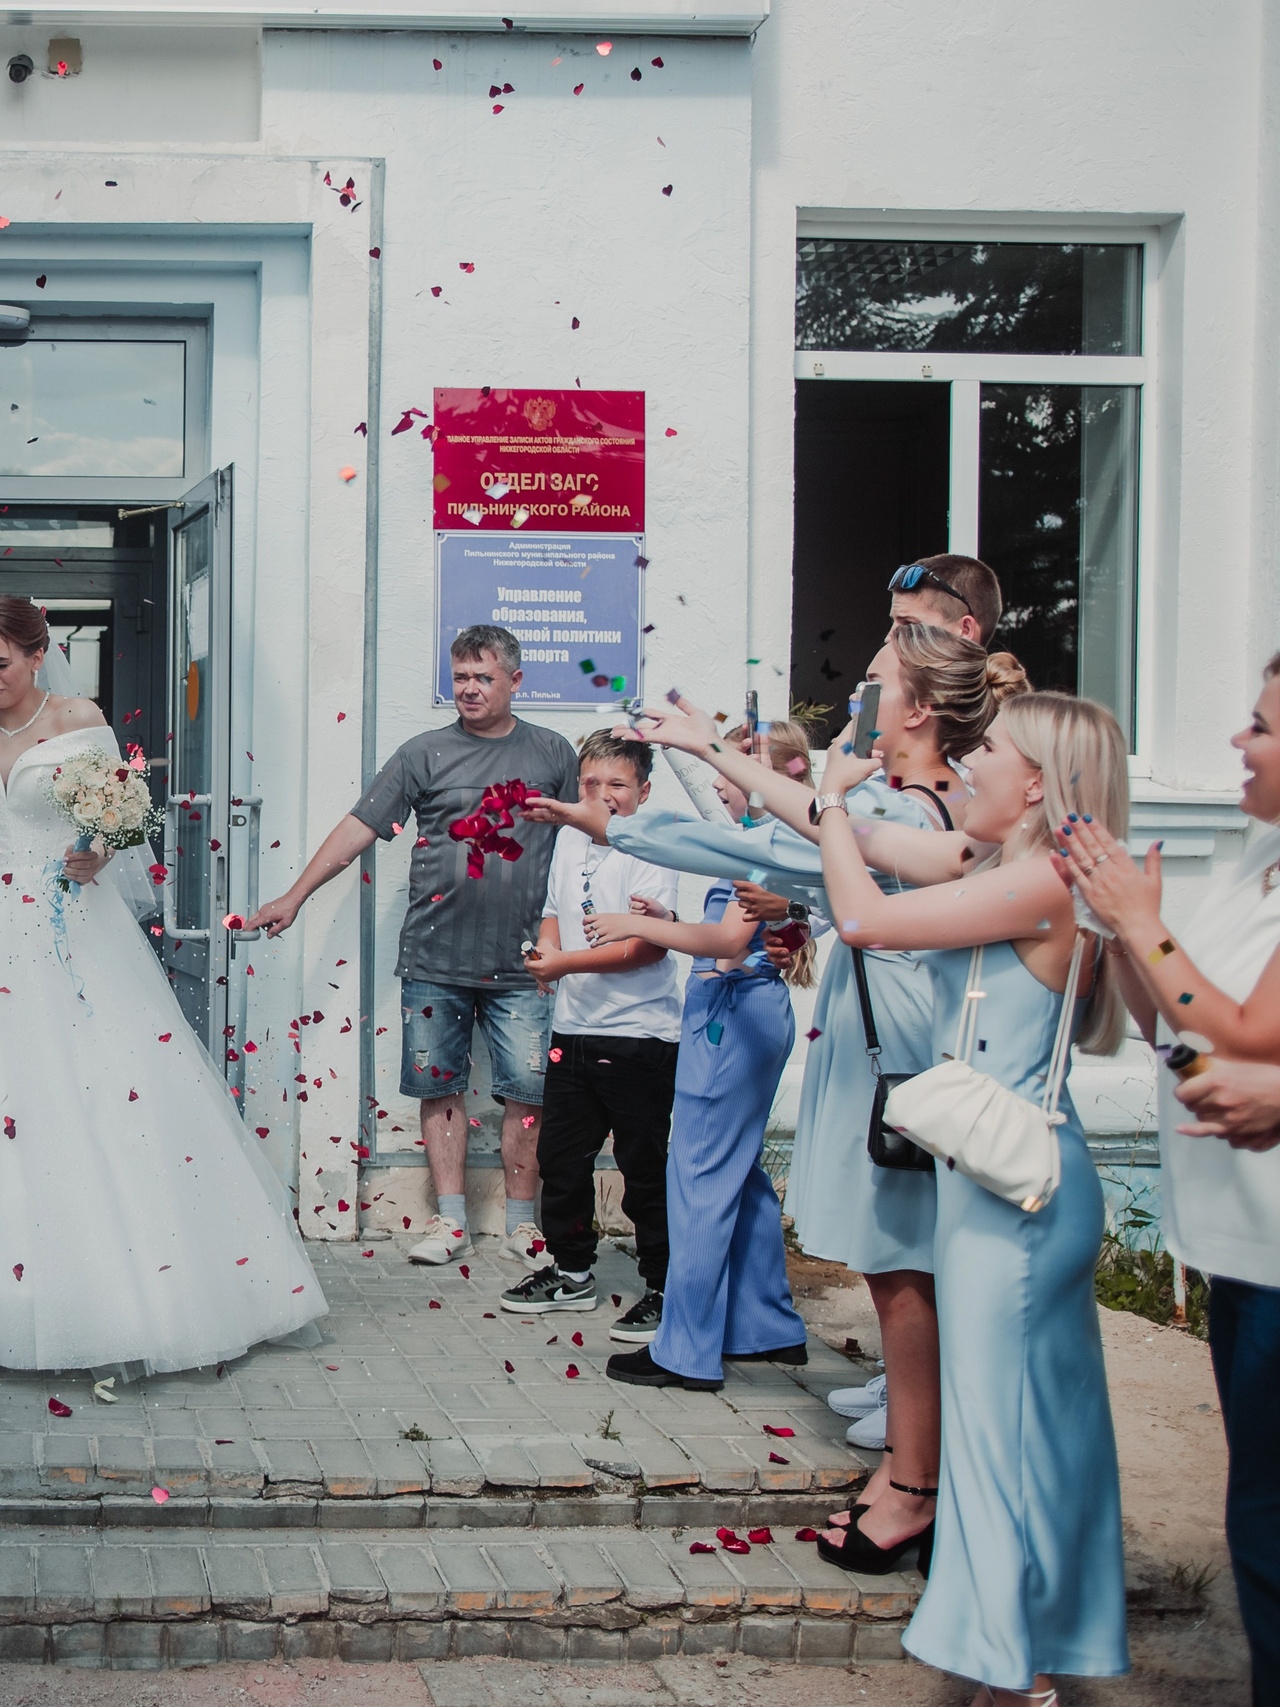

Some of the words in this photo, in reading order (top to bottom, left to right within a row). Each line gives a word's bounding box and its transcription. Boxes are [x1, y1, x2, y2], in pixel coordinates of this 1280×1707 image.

[471, 436, 509, 444] УПРАВЛЕНИЕ
[510, 436, 533, 444] ЗАПИСИ
[534, 436, 552, 444] АКТОВ
[553, 437, 599, 445] ГРАЖДАНСКОГО
[600, 437, 635, 446] СОСТОЯНИЯ
[499, 445, 551, 454] НИЖЕГОРОДСКОЙ
[552, 446, 580, 454] ОБЛАСТИ
[571, 502, 631, 517] РАЙОНА
[509, 541, 571, 551] Администрация
[464, 549, 519, 558] Пильнинского
[521, 551, 586, 560] муниципального
[587, 552, 615, 561] района
[493, 559, 553, 568] Нижегородской
[554, 559, 586, 568] области
[497, 587, 582, 604] Управление
[491, 607, 587, 624] образования,
[553, 630, 622, 643] политики
[521, 649, 569, 663] спорта
[531, 691, 561, 699] Пильна
